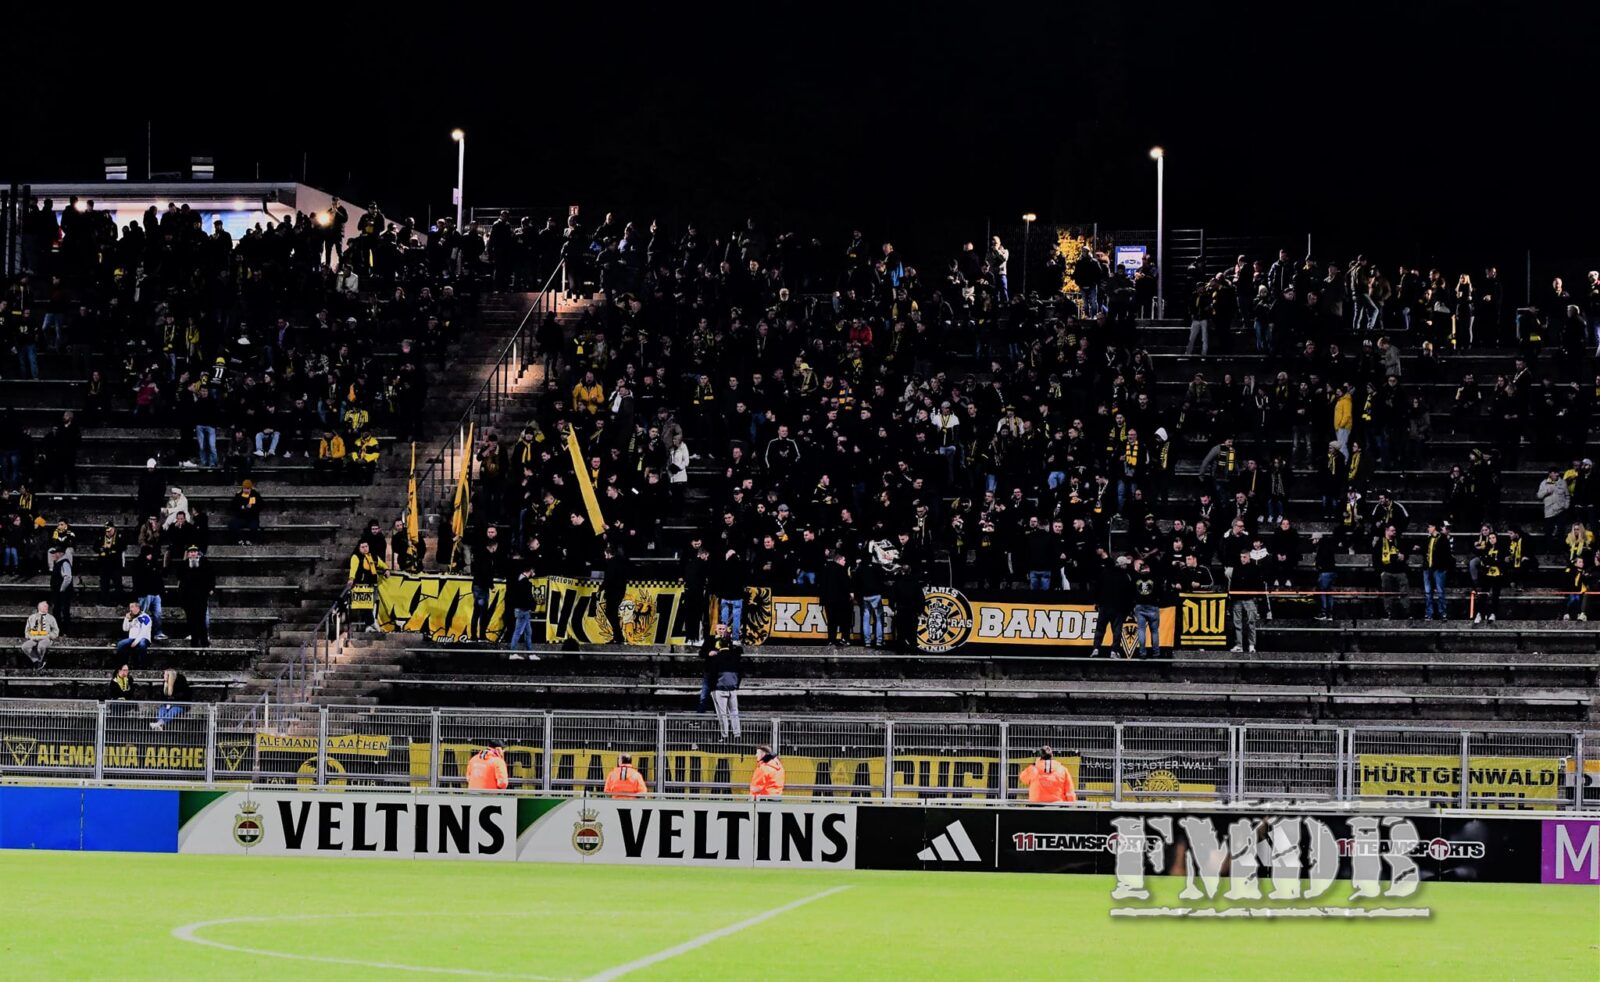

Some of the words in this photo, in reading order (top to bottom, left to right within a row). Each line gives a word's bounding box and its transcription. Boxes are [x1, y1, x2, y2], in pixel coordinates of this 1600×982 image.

[260, 735, 334, 748] ALEMANNA
[144, 747, 207, 768] AACHE
[1363, 763, 1555, 786] HÜRTGENWALD
[277, 801, 505, 854] VELTINS
[617, 808, 849, 863] VELTINS
